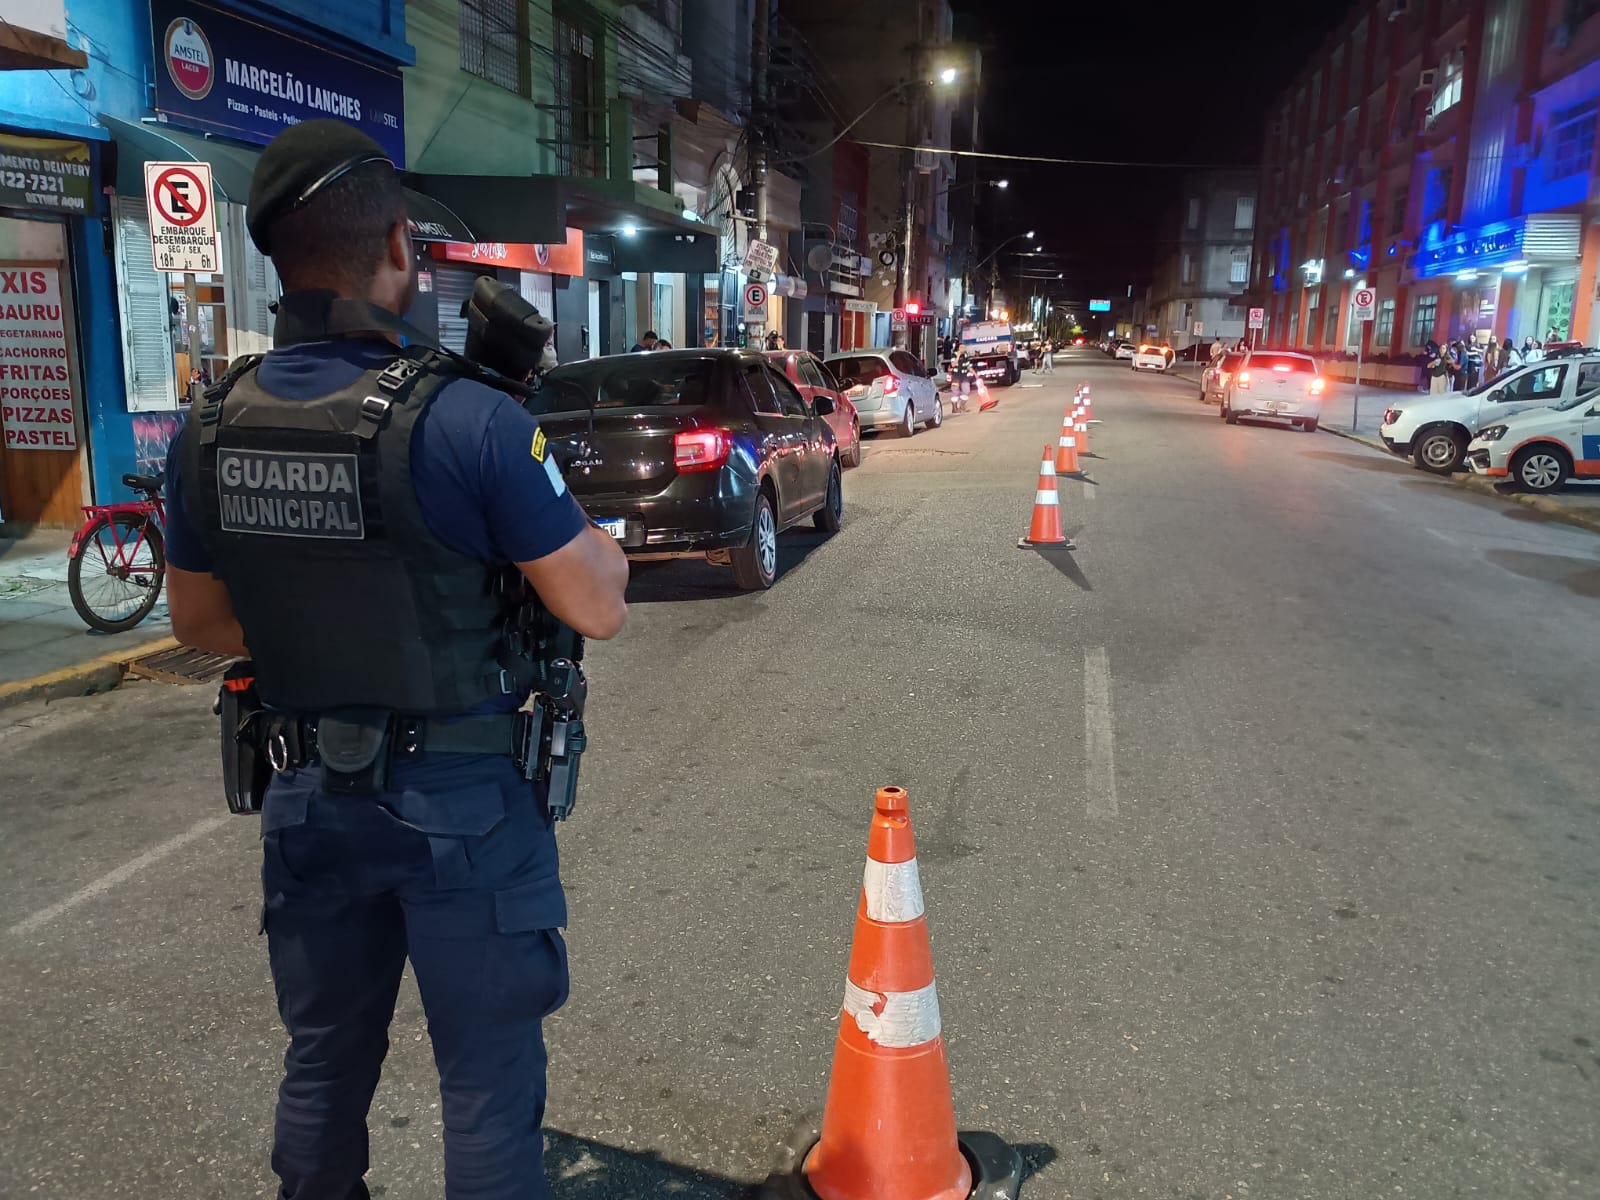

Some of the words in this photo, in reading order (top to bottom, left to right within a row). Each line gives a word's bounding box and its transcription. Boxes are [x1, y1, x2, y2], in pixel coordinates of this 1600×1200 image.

[174, 43, 205, 63] AMSTEL
[225, 58, 304, 104] MARCELÃO
[306, 84, 361, 121] LANCHES
[227, 98, 249, 114] Pizzas
[43, 160, 91, 177] DELIVERY
[61, 196, 84, 209] AQUI
[161, 226, 207, 236] EMBARQUE
[153, 235, 215, 246] DESEMBARQUE
[168, 245, 181, 253] SEG
[189, 246, 201, 254] SEX
[160, 253, 174, 267] 18h
[201, 254, 211, 268] 6h
[0, 271, 47, 294] XIS
[752, 289, 760, 302] E
[0, 329, 63, 338] EGETARIANO
[0, 365, 67, 380] FRITAS
[1, 386, 70, 402] PORÇÕES
[3, 406, 72, 423] PIZZAS
[5, 430, 75, 446] PASTEL
[221, 456, 353, 493] GUARDA
[223, 494, 358, 531] MUNICIPAL
